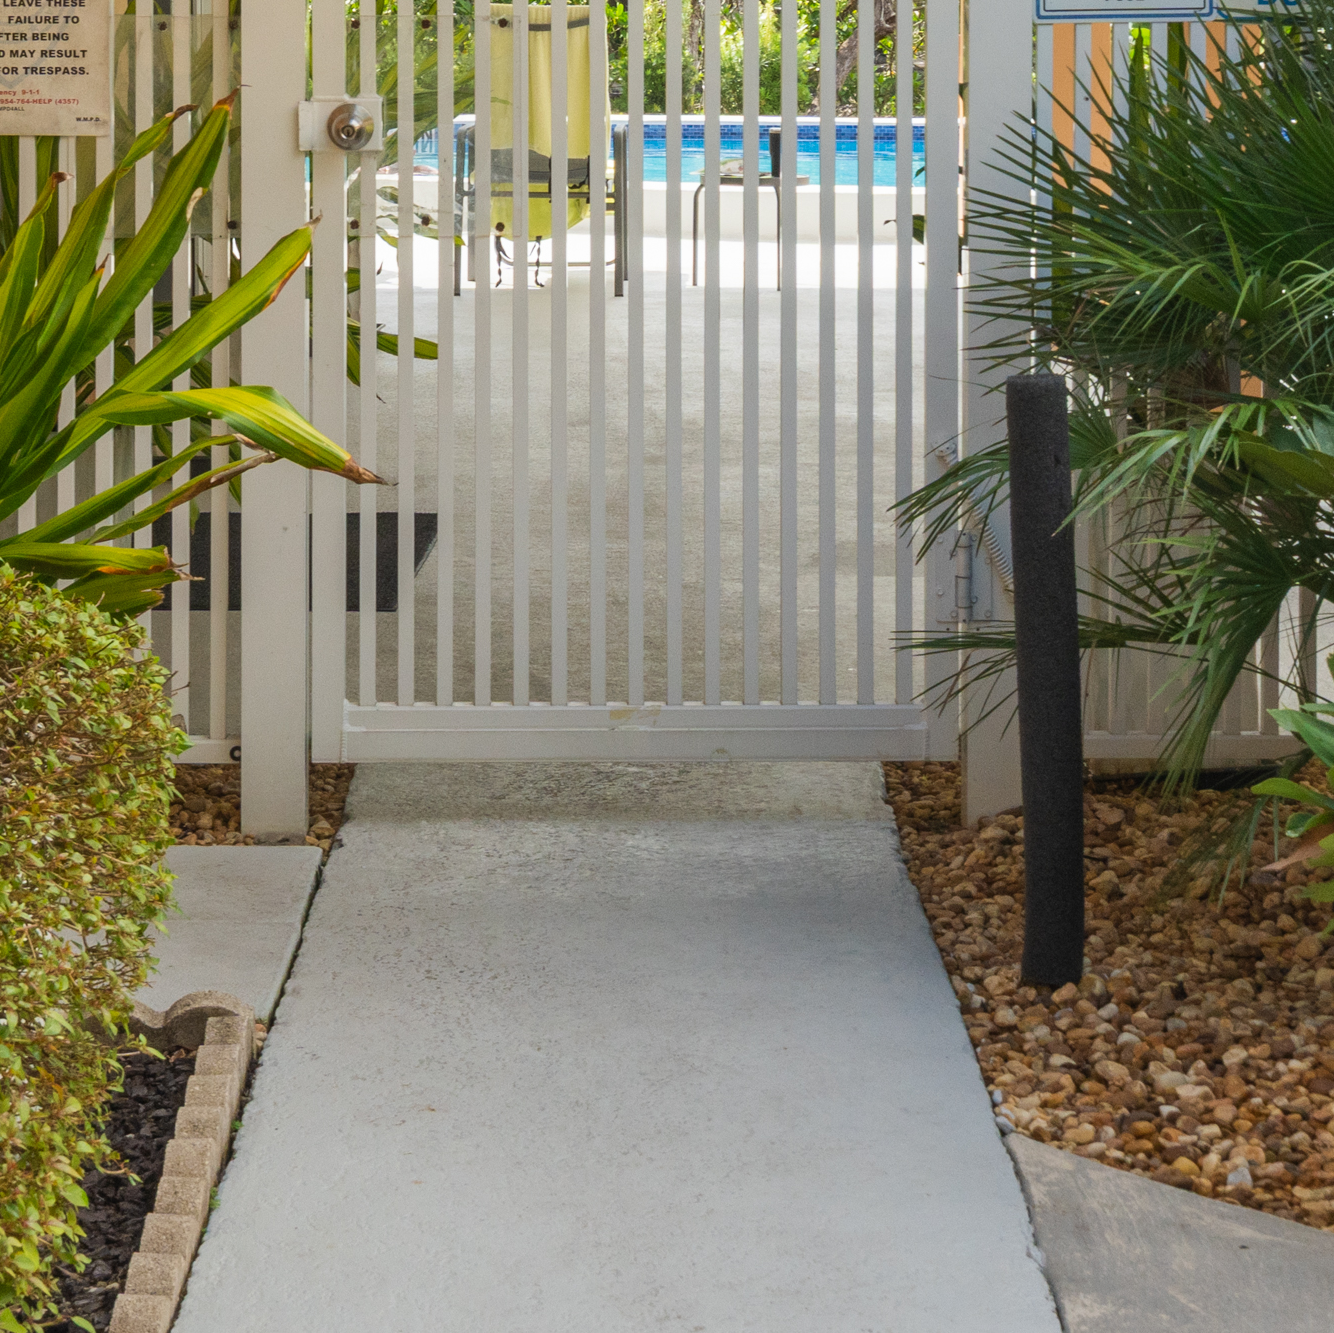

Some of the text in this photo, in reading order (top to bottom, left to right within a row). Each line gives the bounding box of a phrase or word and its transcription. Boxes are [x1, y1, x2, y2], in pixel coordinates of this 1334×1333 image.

[7, 15, 60, 25] FAILURE
[63, 15, 80, 25] TO
[31, 32, 70, 42] BEING
[9, 49, 36, 59] MAY
[40, 49, 88, 59] RESULT
[22, 66, 89, 76] TRESPASS.
[54, 98, 79, 106] (4357)
